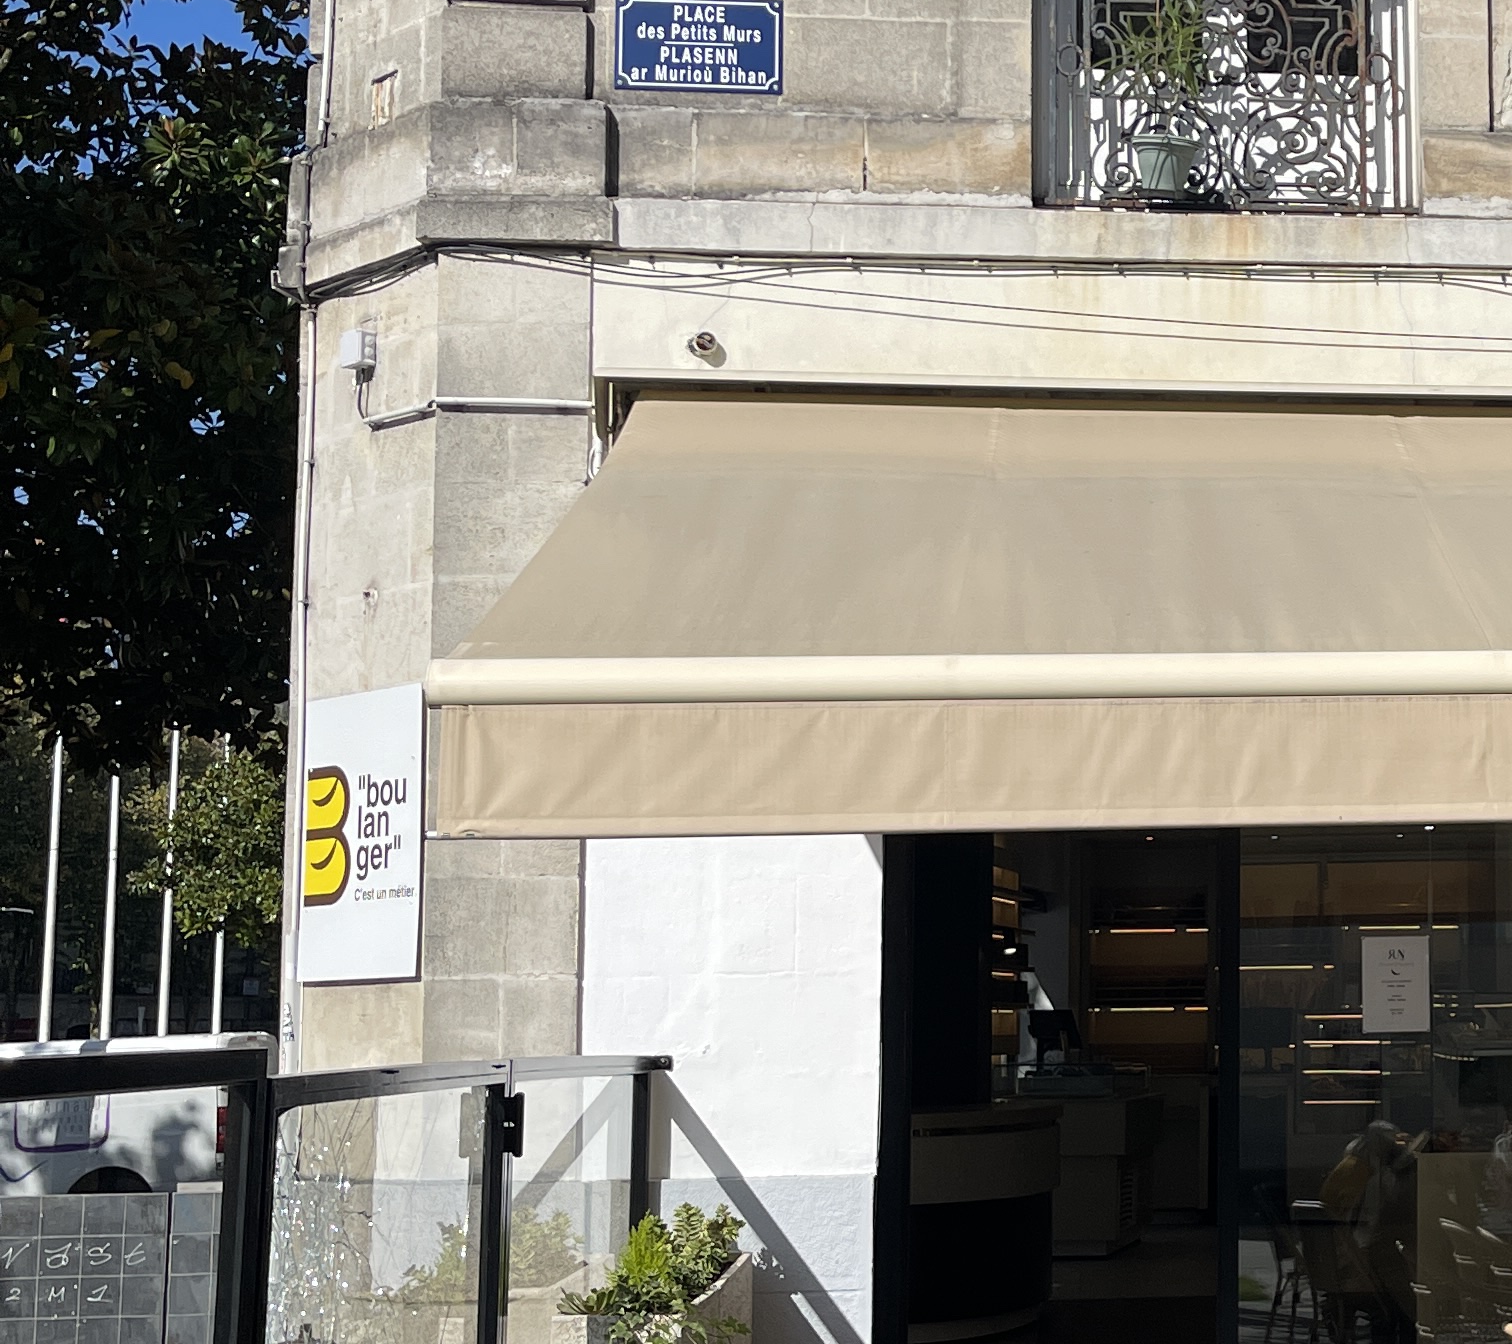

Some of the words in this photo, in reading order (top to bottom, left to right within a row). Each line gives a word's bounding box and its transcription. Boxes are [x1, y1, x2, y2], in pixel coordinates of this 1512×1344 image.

[673, 5, 726, 23] PLACE
[637, 22, 665, 39] des
[671, 23, 717, 41] Petits
[723, 25, 762, 43] Murs
[660, 46, 738, 65] PLASENN
[630, 66, 648, 80] ar
[655, 64, 713, 83] Murioù
[720, 67, 767, 84] Bihan
[357, 806, 390, 839] lan
[354, 887, 375, 901] C'est
[376, 889, 387, 899] un
